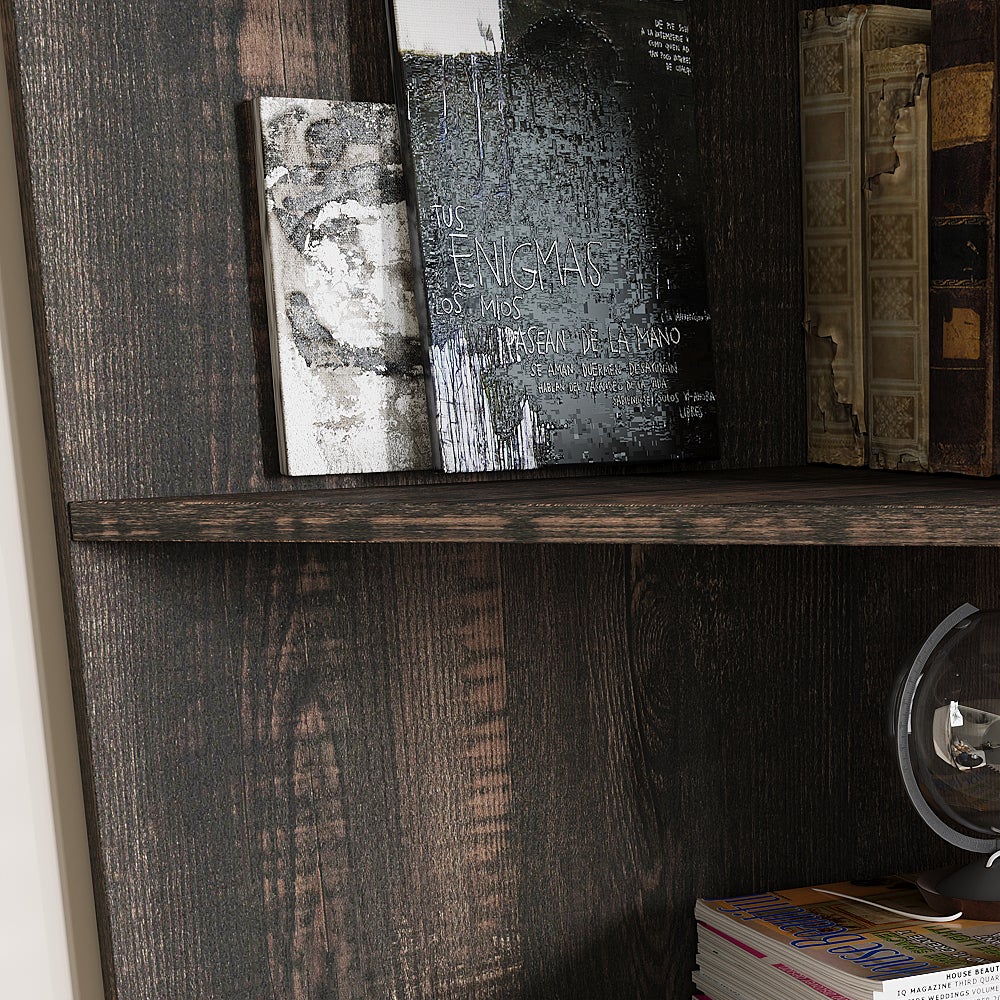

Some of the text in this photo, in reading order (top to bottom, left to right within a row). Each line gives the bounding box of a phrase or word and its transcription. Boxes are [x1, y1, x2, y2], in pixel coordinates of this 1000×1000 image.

[430, 204, 466, 231] TUS
[449, 233, 602, 291] ENIGMAS
[435, 292, 523, 320] LOS MIOS
[506, 325, 681, 355] PASEAN DE LA MANO
[530, 363, 542, 377] SE
[548, 363, 574, 378] AMAN
[897, 989, 907, 997] IQ
[910, 982, 952, 994] MAGAZINE
[955, 976, 977, 987] THIRD
[946, 971, 972, 980] HOUSE
[972, 985, 1000, 995] VOLUME
